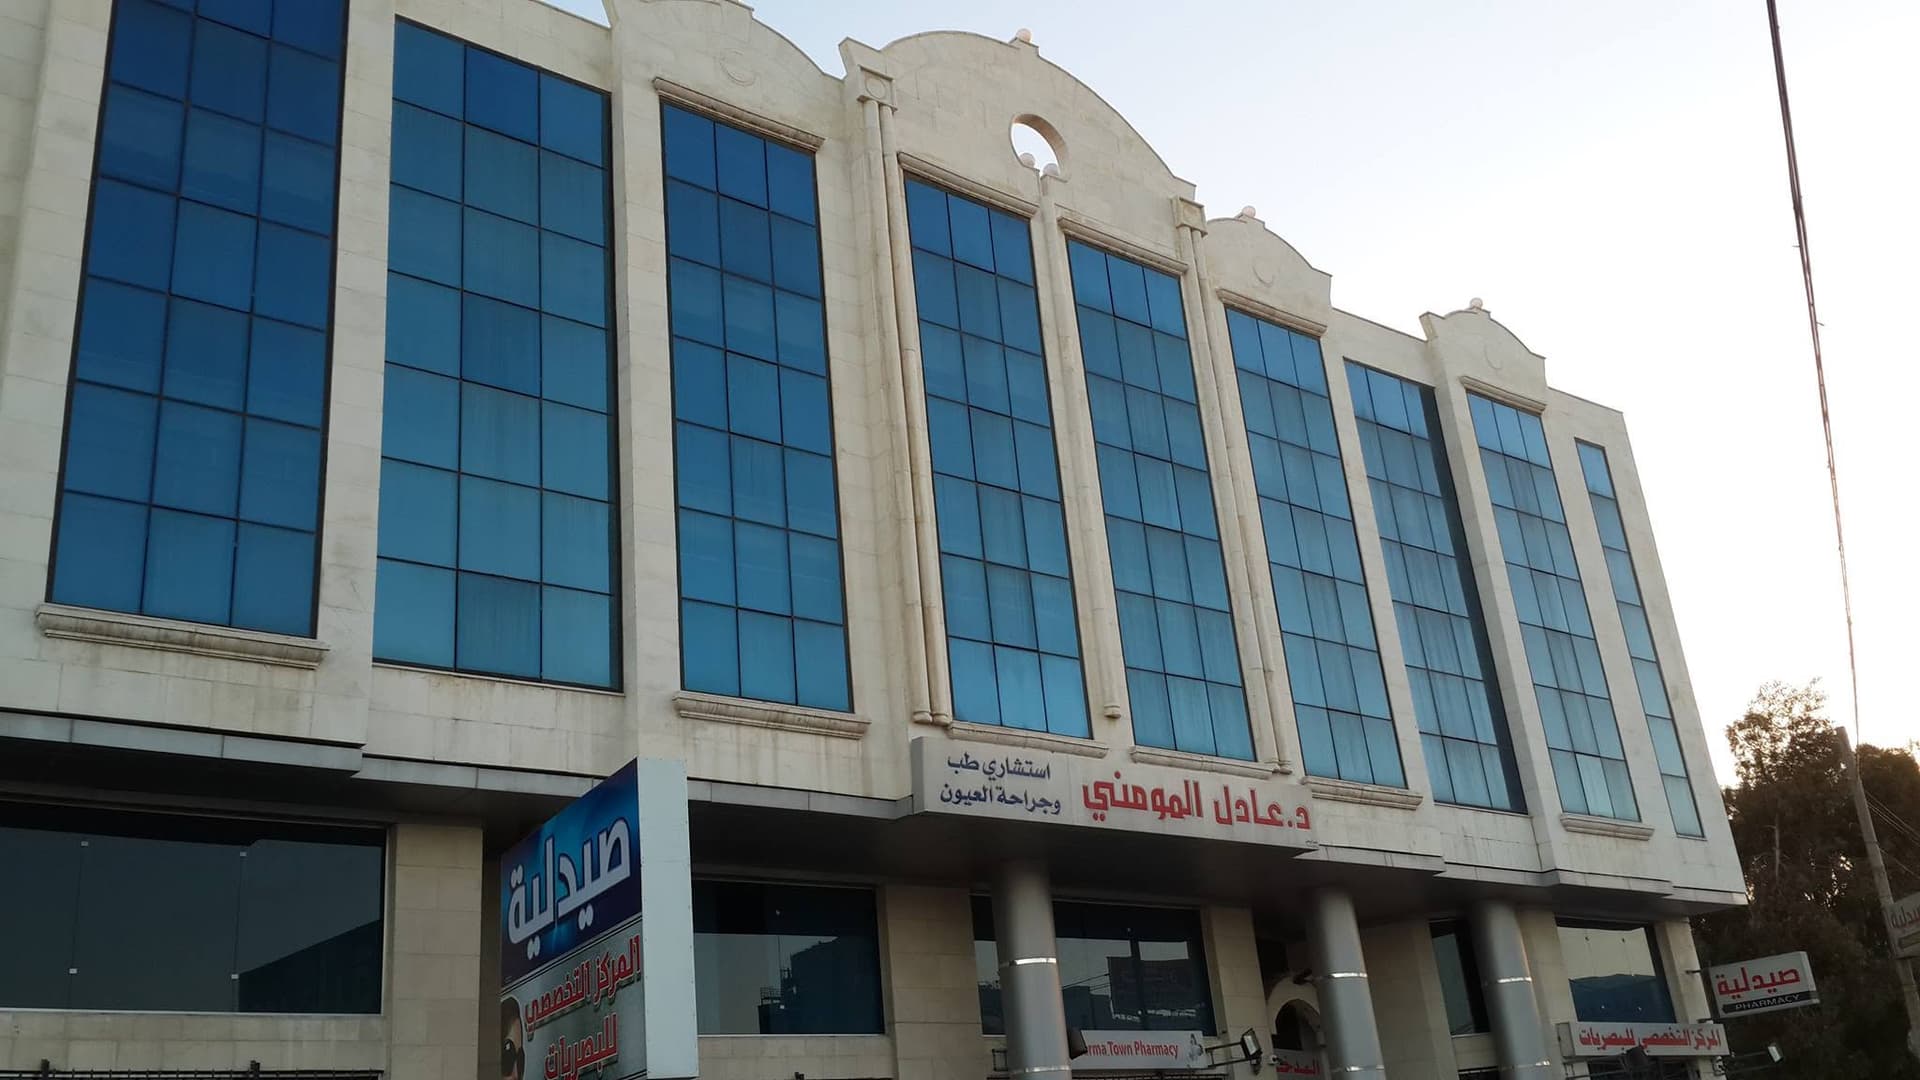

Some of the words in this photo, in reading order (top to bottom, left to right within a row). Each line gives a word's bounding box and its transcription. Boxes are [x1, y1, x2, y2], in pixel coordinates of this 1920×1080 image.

[947, 751, 979, 774] طب
[982, 757, 1051, 781] استشاري
[940, 783, 993, 806] العيون
[996, 785, 1061, 815] وجراحة
[1082, 770, 1204, 822] المومني
[508, 817, 631, 960] صيدلية
[593, 934, 641, 1005] المركز
[1716, 966, 1801, 999] صيدلية
[524, 959, 591, 1035] التخصصي
[1735, 994, 1800, 1011] PHARMACY
[544, 1011, 618, 1080] للبصريات
[1107, 1041, 1133, 1057] Town
[1134, 1040, 1179, 1060] Pharmacy
[1579, 1027, 1636, 1051] للبصريات
[1639, 1026, 1691, 1053] التخصصي
[1693, 1027, 1722, 1051] المركز
